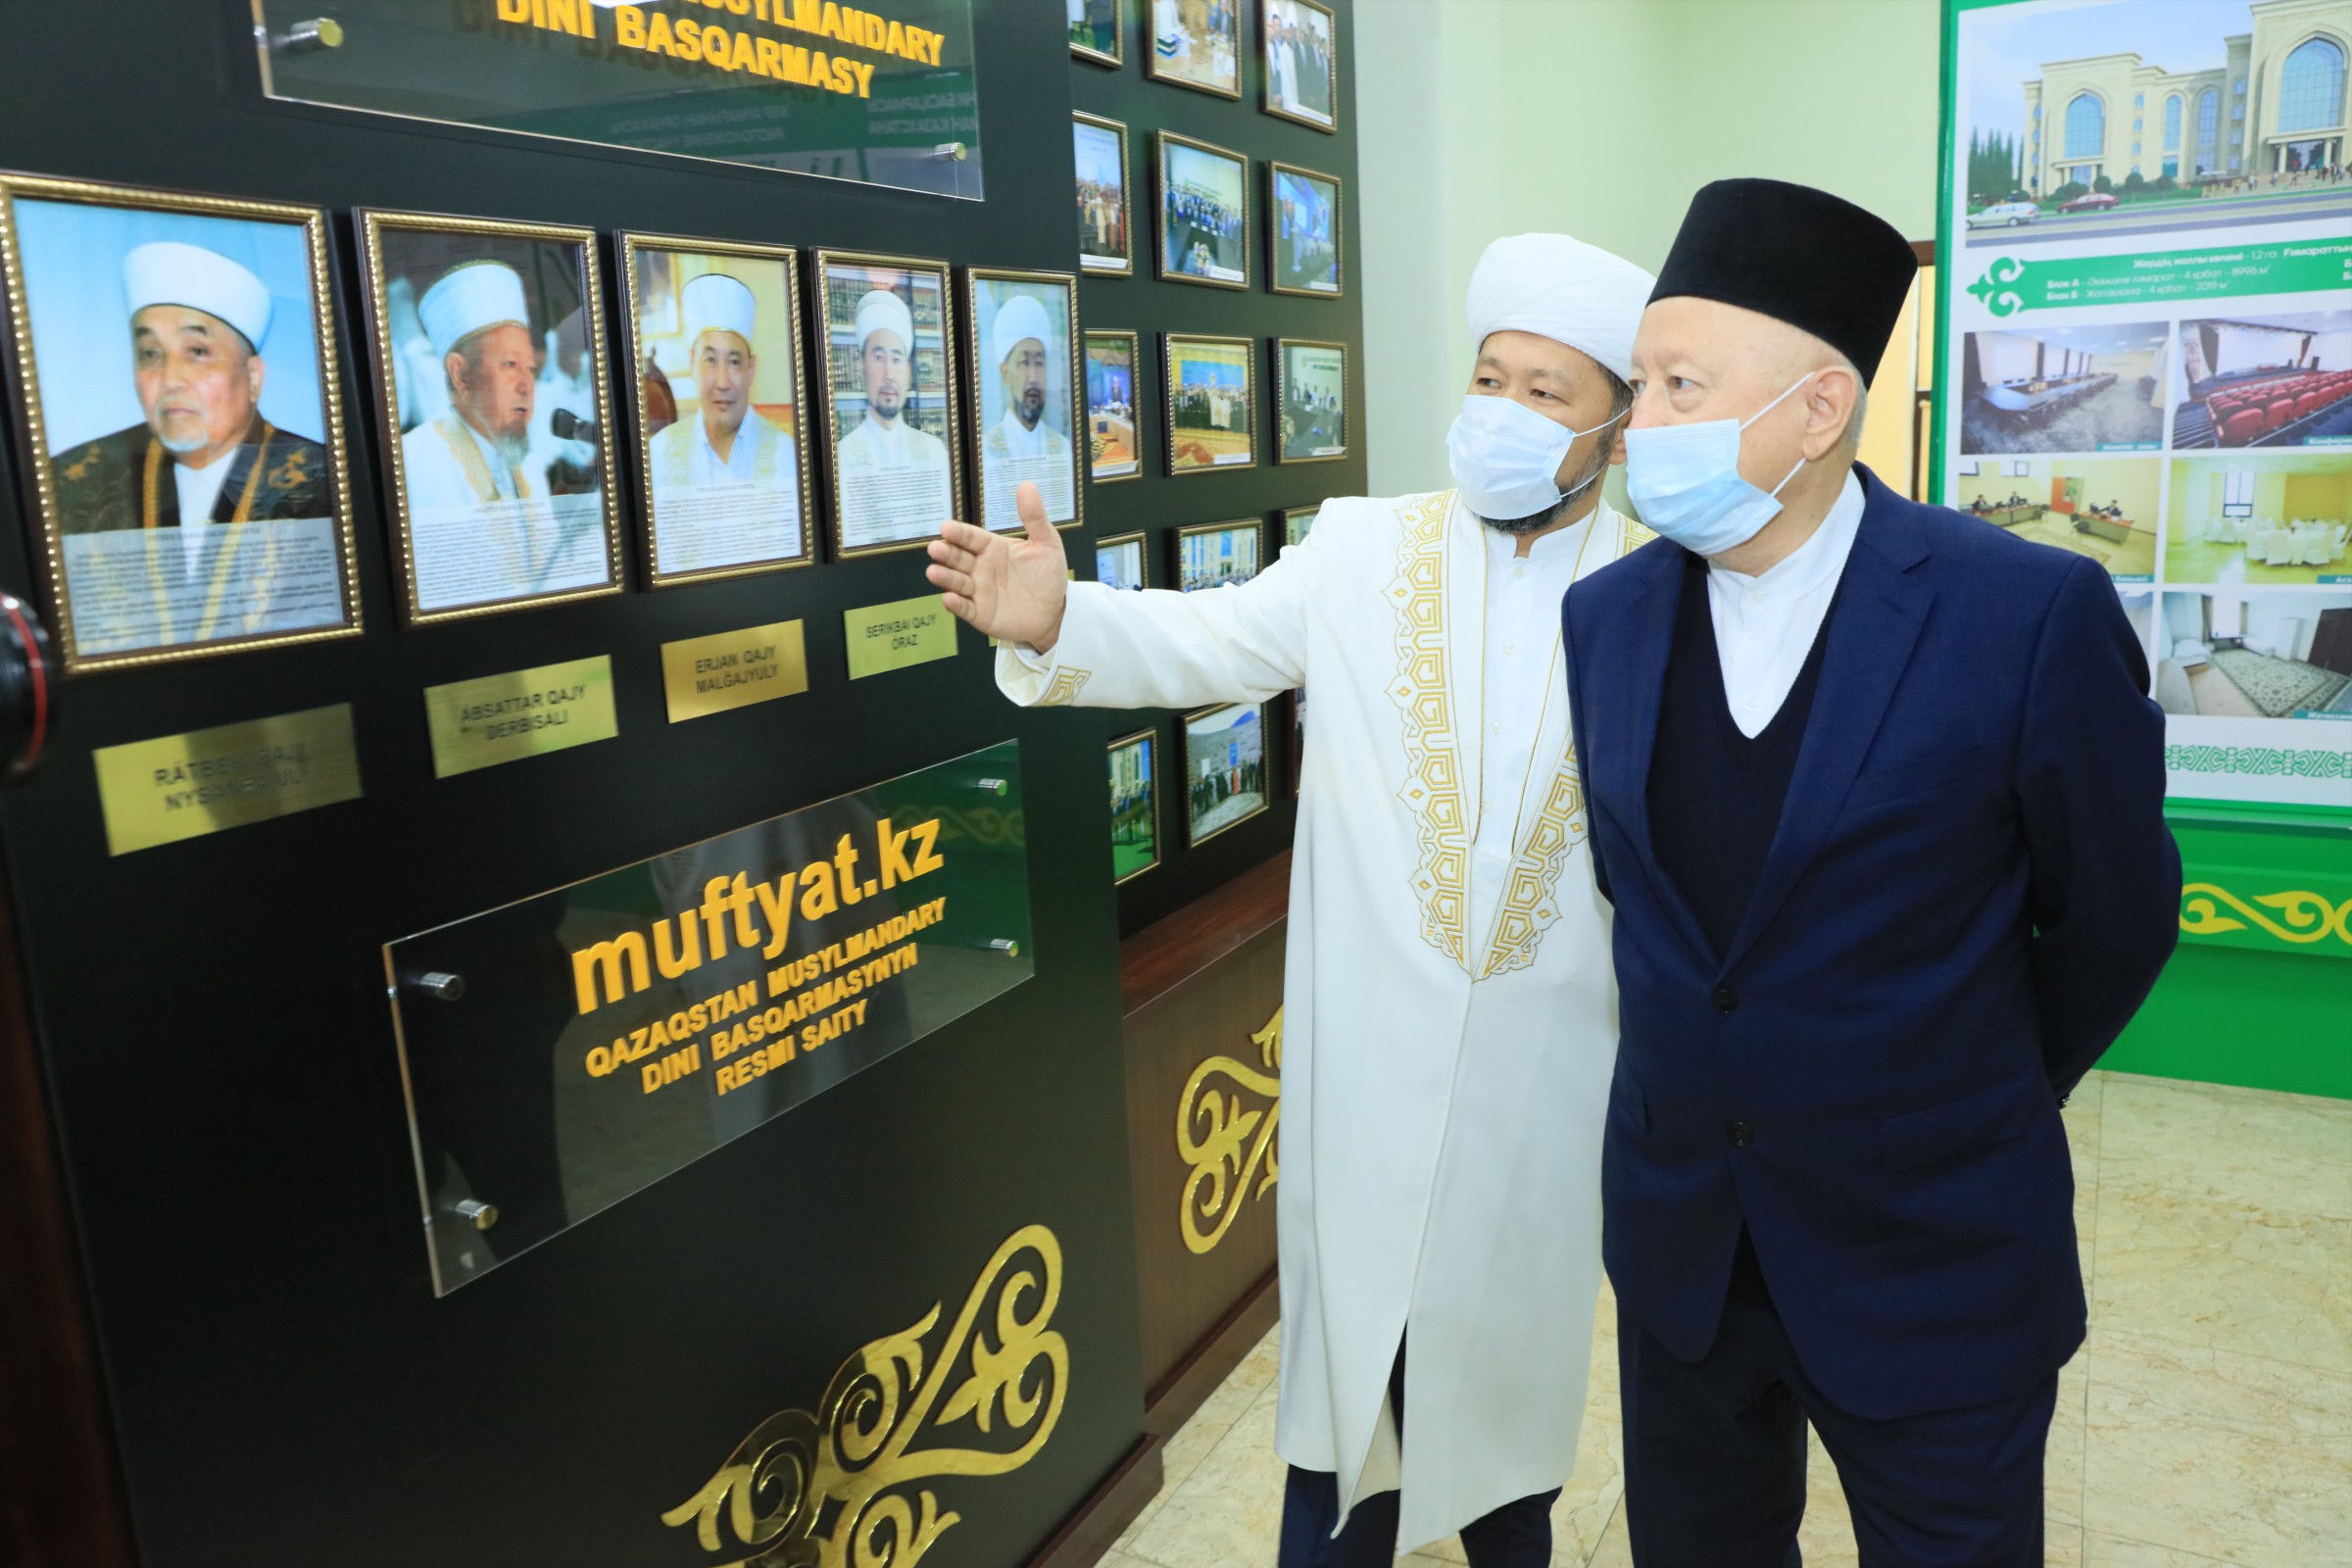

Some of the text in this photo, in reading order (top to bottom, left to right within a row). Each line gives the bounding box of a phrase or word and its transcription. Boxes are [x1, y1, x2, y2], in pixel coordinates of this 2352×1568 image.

[614, 5, 874, 97] BASQARMASY
[695, 645, 777, 674] ERJAN QAJY
[865, 612, 938, 639] SERIKBAI QAJY
[891, 633, 919, 650] ORAZ
[547, 684, 587, 705] QAJY
[571, 818, 944, 1015] muftyat.kz
[586, 897, 947, 1078] QAZAQSTAN MUSYLMANDARY
[642, 943, 918, 1095] DINI BASQARMASYNYN
[716, 999, 868, 1097] RESMI SAITY
